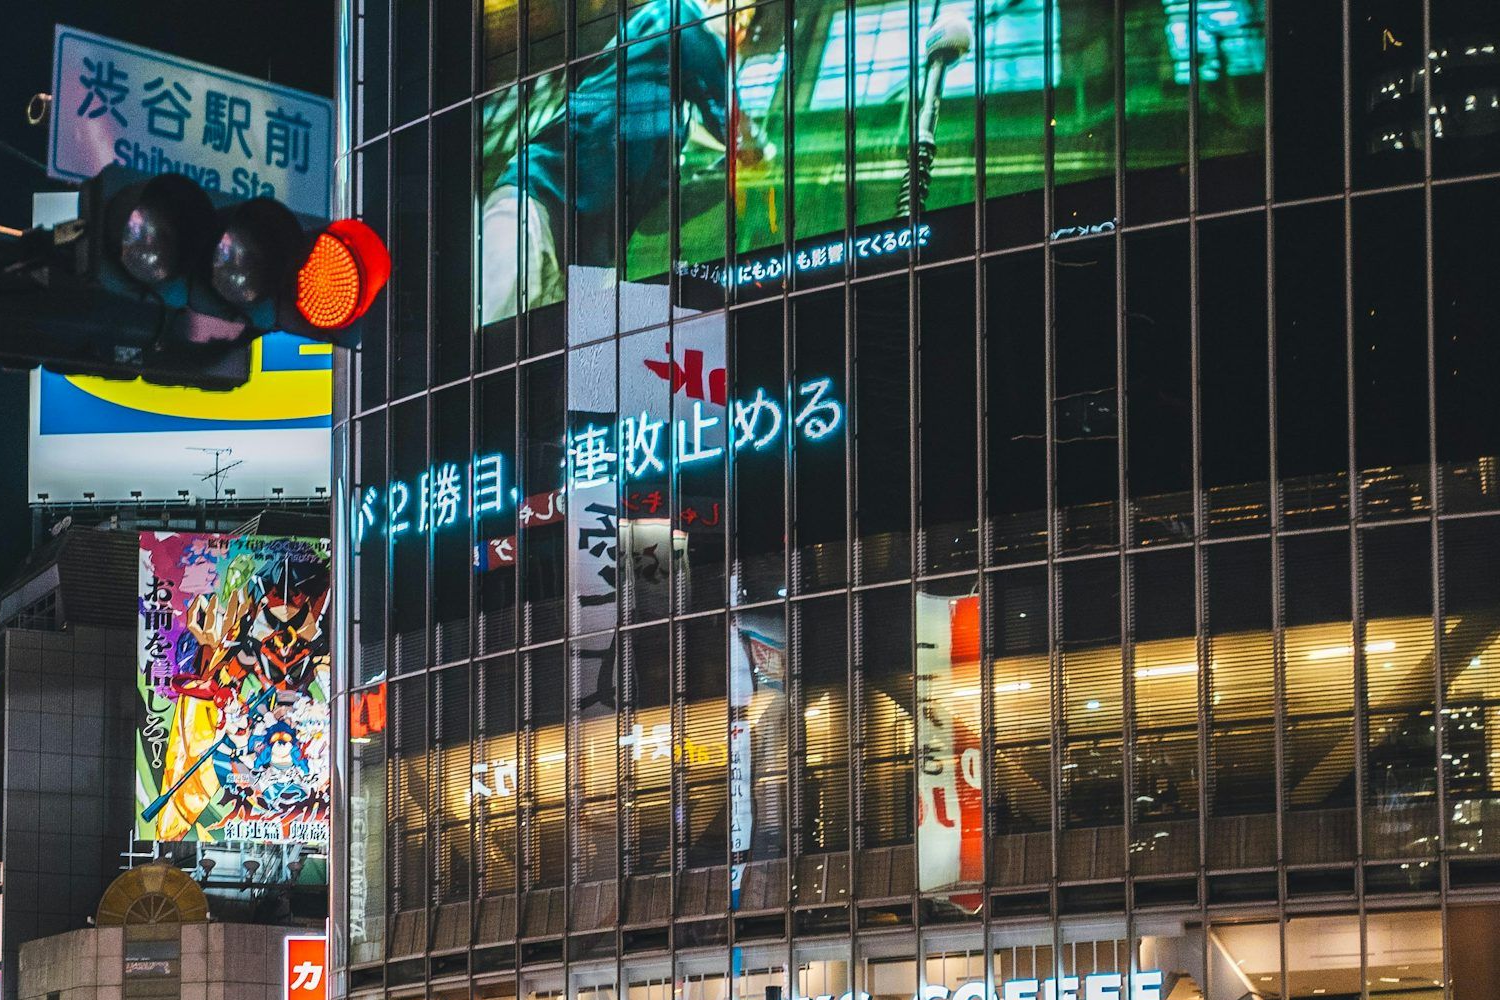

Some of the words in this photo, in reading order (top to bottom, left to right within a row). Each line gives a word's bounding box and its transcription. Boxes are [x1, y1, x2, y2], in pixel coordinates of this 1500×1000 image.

[78, 55, 312, 175] 渋谷駅前
[113, 138, 221, 194] Shibuya
